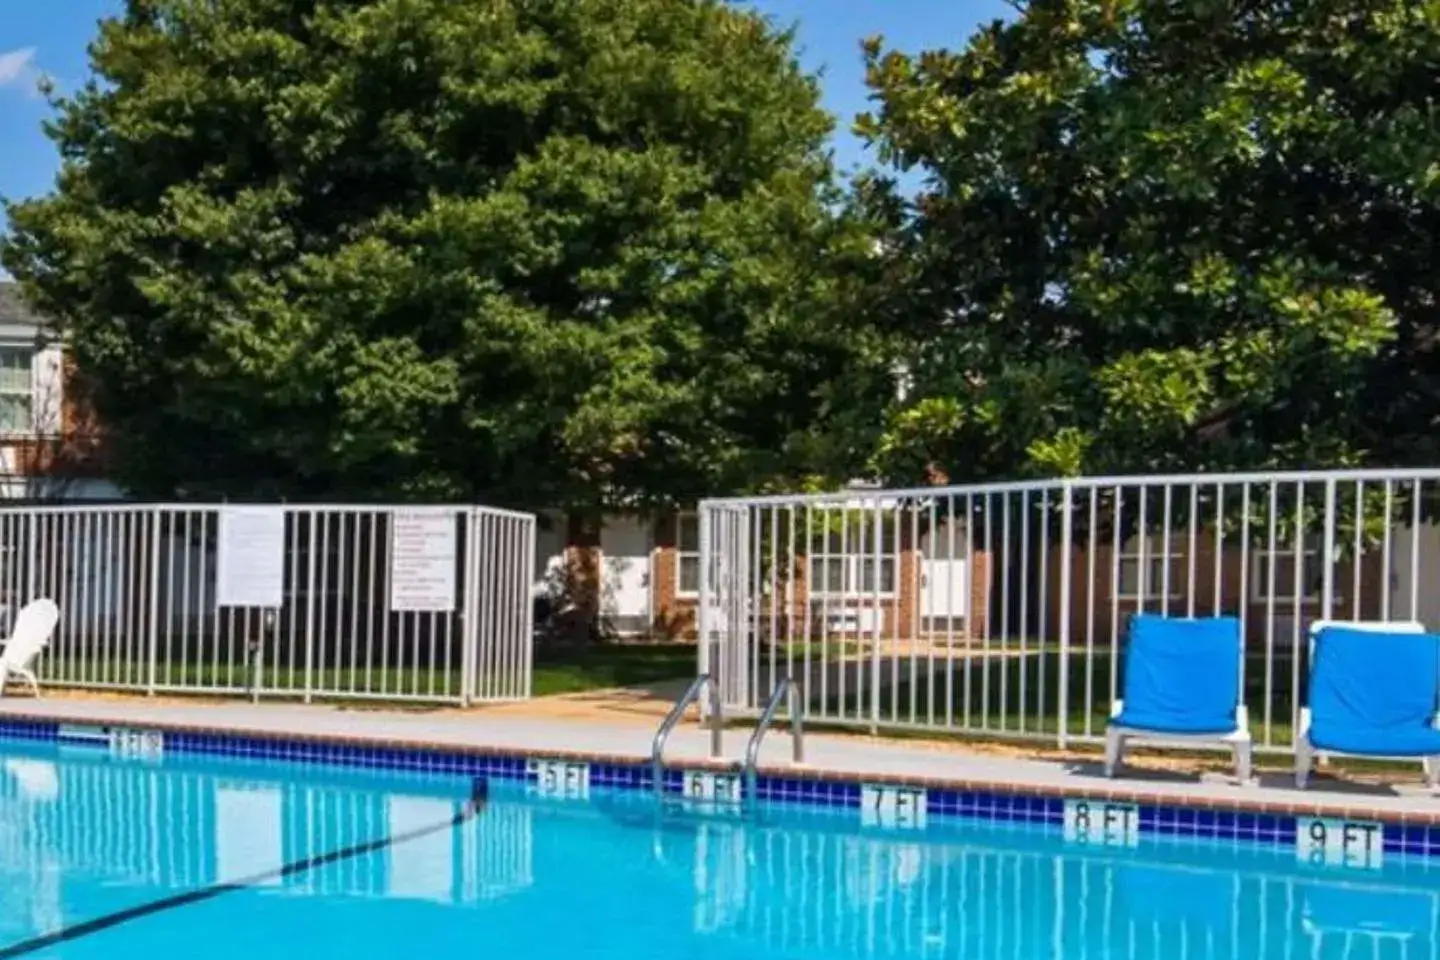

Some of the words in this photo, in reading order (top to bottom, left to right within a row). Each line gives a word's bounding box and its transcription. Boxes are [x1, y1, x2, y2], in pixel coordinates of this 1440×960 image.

[564, 763, 585, 785] FT
[714, 774, 736, 798] FT
[869, 786, 883, 809] 7
[896, 787, 923, 812] FT
[1075, 803, 1090, 829] 8
[1104, 804, 1135, 831] FT
[1309, 820, 1326, 848] 9
[1342, 822, 1379, 850] FT
